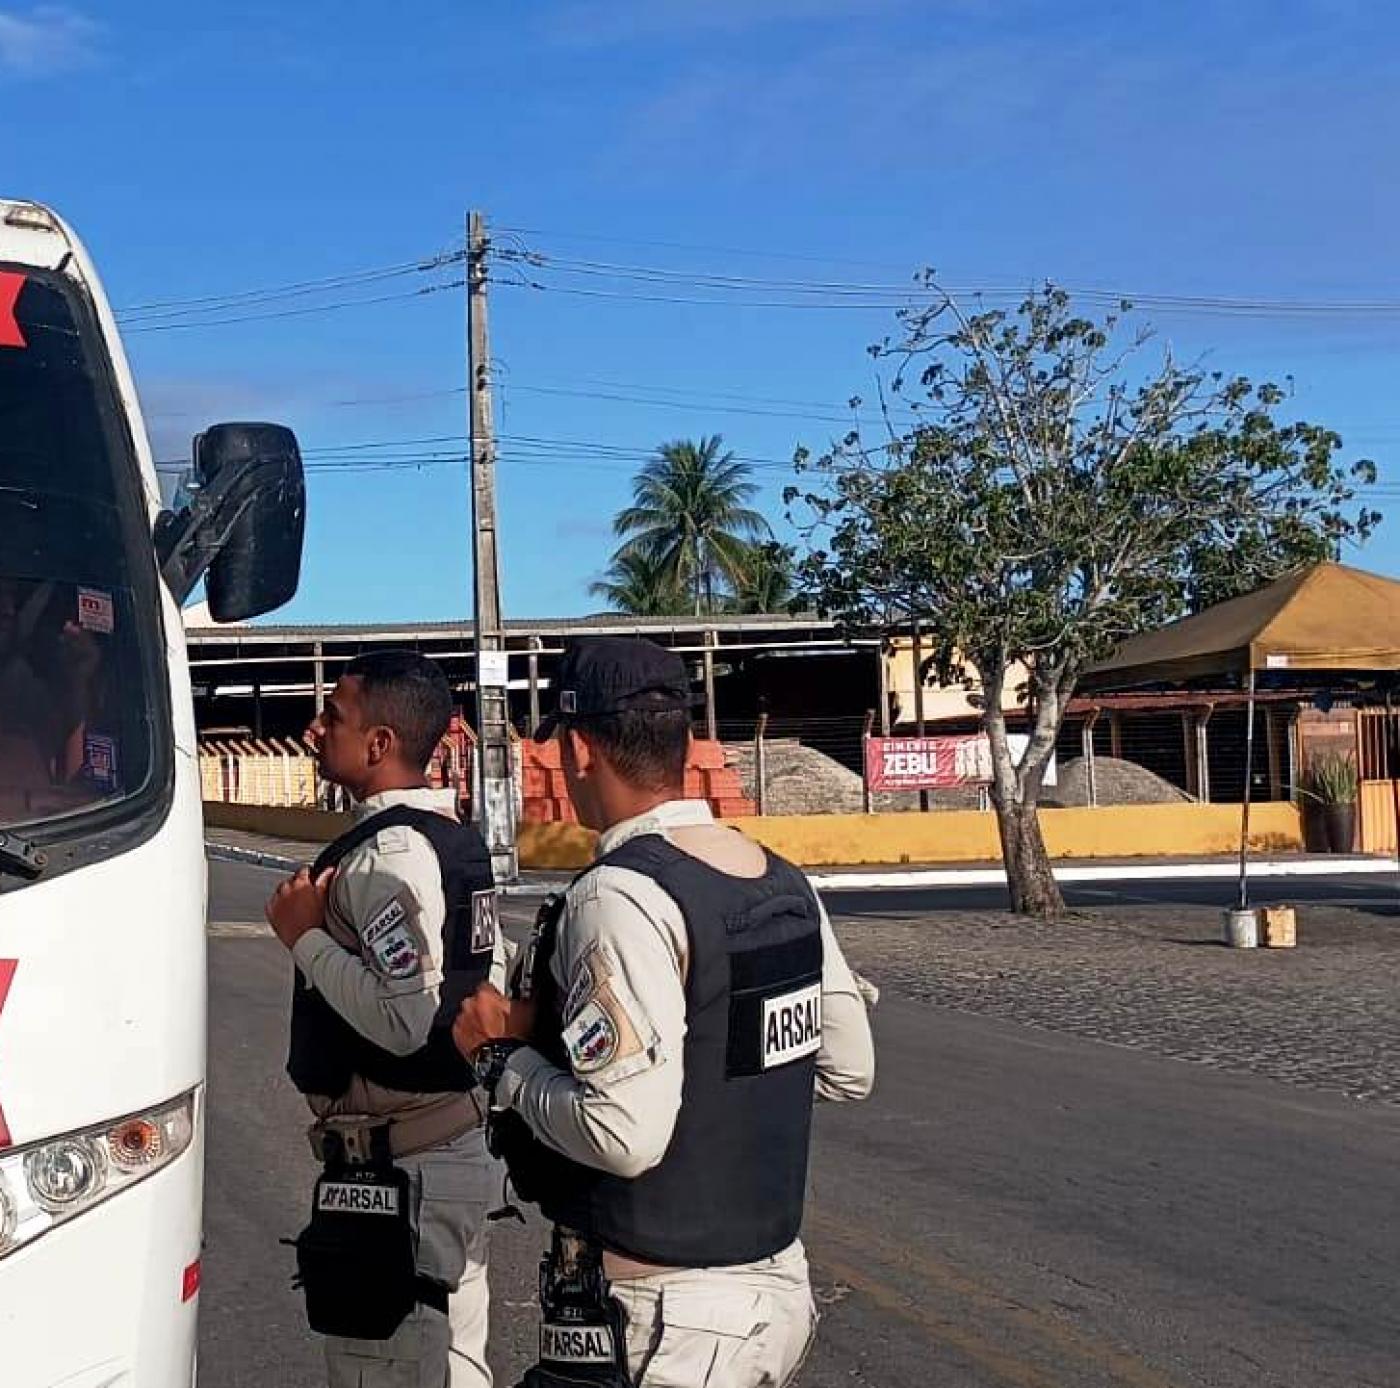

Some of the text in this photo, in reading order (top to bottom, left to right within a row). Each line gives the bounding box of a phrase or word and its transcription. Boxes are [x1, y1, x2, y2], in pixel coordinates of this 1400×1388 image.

[883, 752, 937, 774] ZEBU
[766, 997, 821, 1054] ARSAL
[338, 1186, 396, 1211] ARSAL
[554, 1331, 610, 1358] ARSAL
